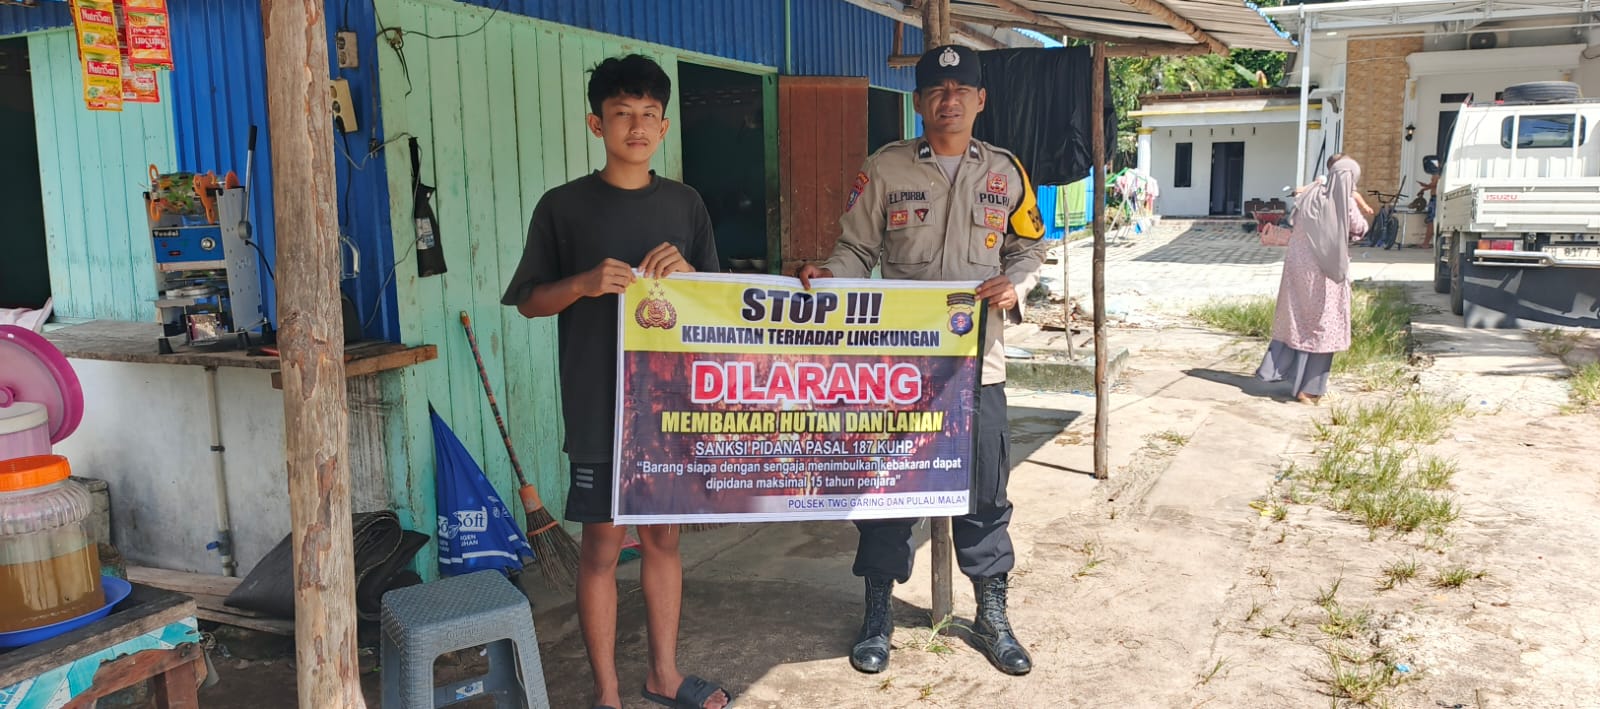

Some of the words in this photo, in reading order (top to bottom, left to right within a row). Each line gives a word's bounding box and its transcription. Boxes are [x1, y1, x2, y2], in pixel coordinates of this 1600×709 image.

[741, 288, 838, 324] STOP
[845, 292, 882, 324] !!!
[682, 325, 764, 344] KEJAHATAN
[768, 328, 844, 346] TERHADAP
[846, 330, 940, 347] LINGKUNGAN
[691, 361, 922, 404] DILARANG
[661, 411, 775, 433] MEMBAKAR
[779, 411, 841, 433] HUTAN
[846, 411, 883, 433] DAN
[887, 411, 943, 433] LAHAN
[695, 441, 748, 456] SANKSI
[751, 441, 802, 455] PIDANA
[806, 441, 848, 455] PASAL
[853, 441, 873, 454] 187
[877, 440, 914, 454] KUHP
[687, 461, 717, 475] siapa
[720, 461, 760, 475] dengan
[763, 460, 805, 475] sengaja
[808, 459, 877, 471] menimbulkan
[880, 459, 930, 471] kebakaran
[933, 457, 962, 471] dapat
[706, 477, 753, 491] dipidana
[756, 477, 807, 488] maksimal
[811, 477, 823, 487] 15
[825, 476, 855, 487] tahun
[788, 499, 825, 509] POLSEK
[828, 499, 848, 508] TWG
[850, 498, 884, 507] GARING
[887, 497, 904, 506] DAN
[907, 496, 935, 505] PULAU
